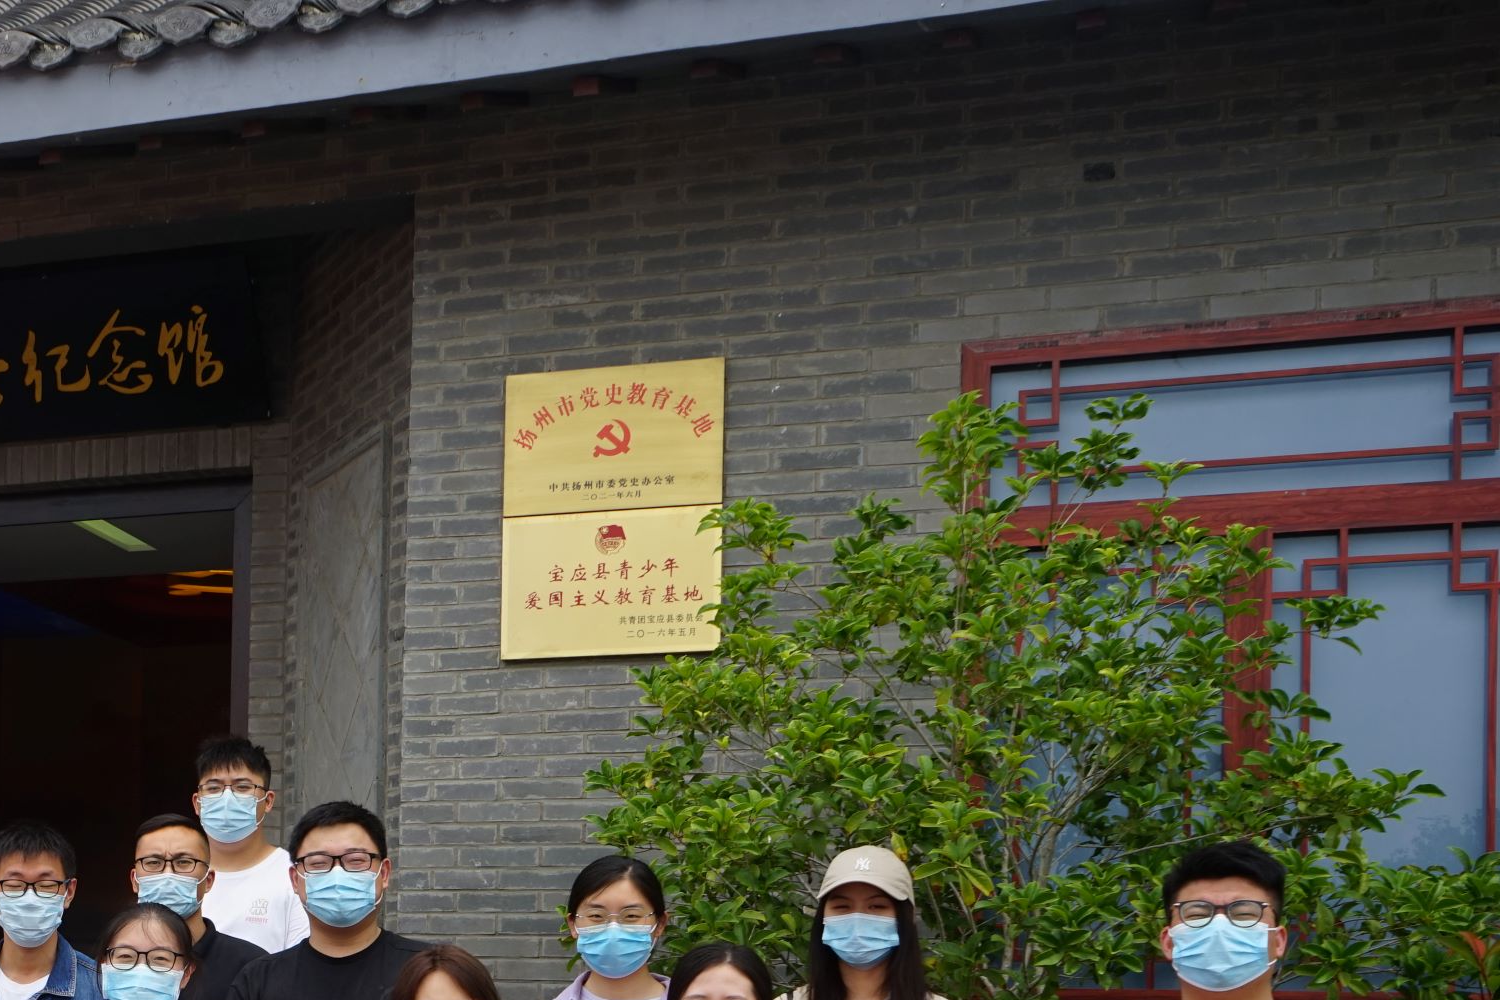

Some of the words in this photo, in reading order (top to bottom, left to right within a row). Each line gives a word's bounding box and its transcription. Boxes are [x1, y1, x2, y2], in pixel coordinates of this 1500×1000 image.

[513, 381, 716, 451] 扬州市党史教育基地
[549, 474, 676, 493] 中共扬州市委党史办公室
[548, 557, 680, 584] 宝应县青少年
[524, 584, 704, 611] 爱国主义教育基地
